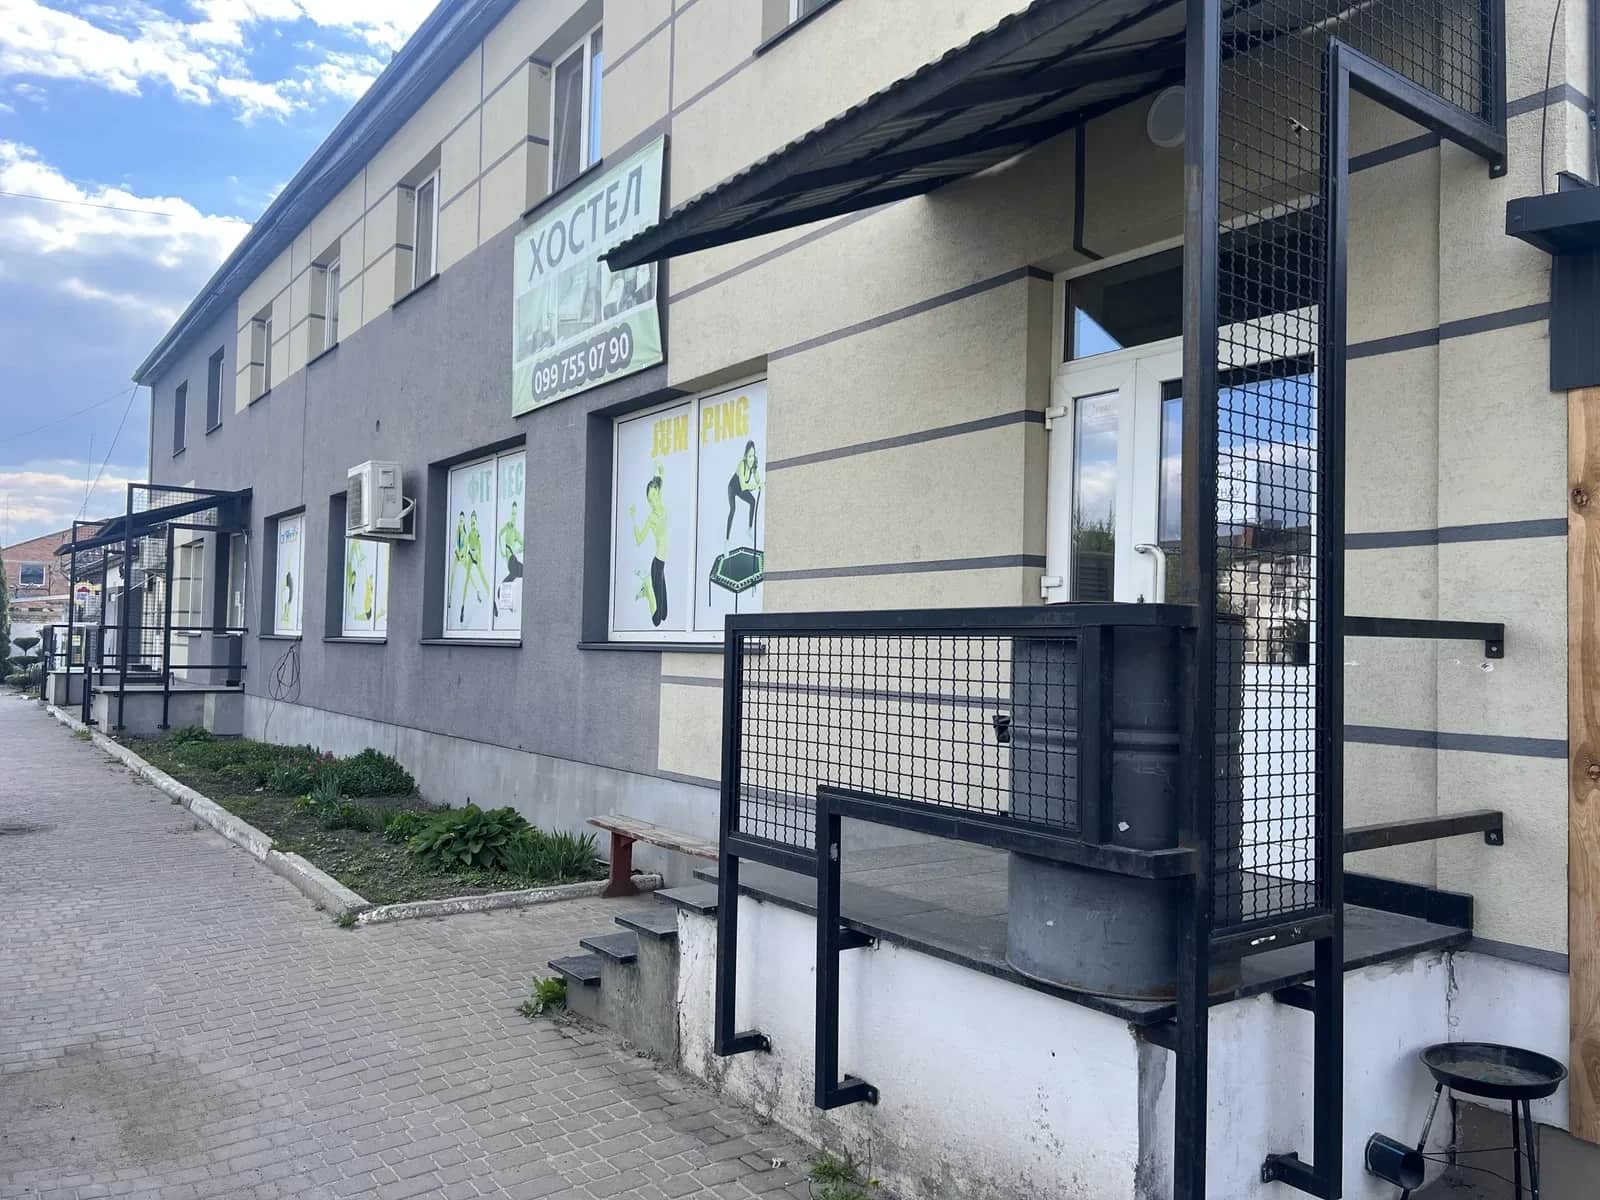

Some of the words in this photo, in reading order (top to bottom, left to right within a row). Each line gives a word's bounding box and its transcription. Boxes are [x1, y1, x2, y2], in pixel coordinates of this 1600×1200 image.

[528, 165, 643, 282] ХОСТЕЛ
[534, 363, 559, 394] 099
[561, 351, 586, 384] 755
[588, 341, 606, 372] 07
[609, 332, 630, 364] 90
